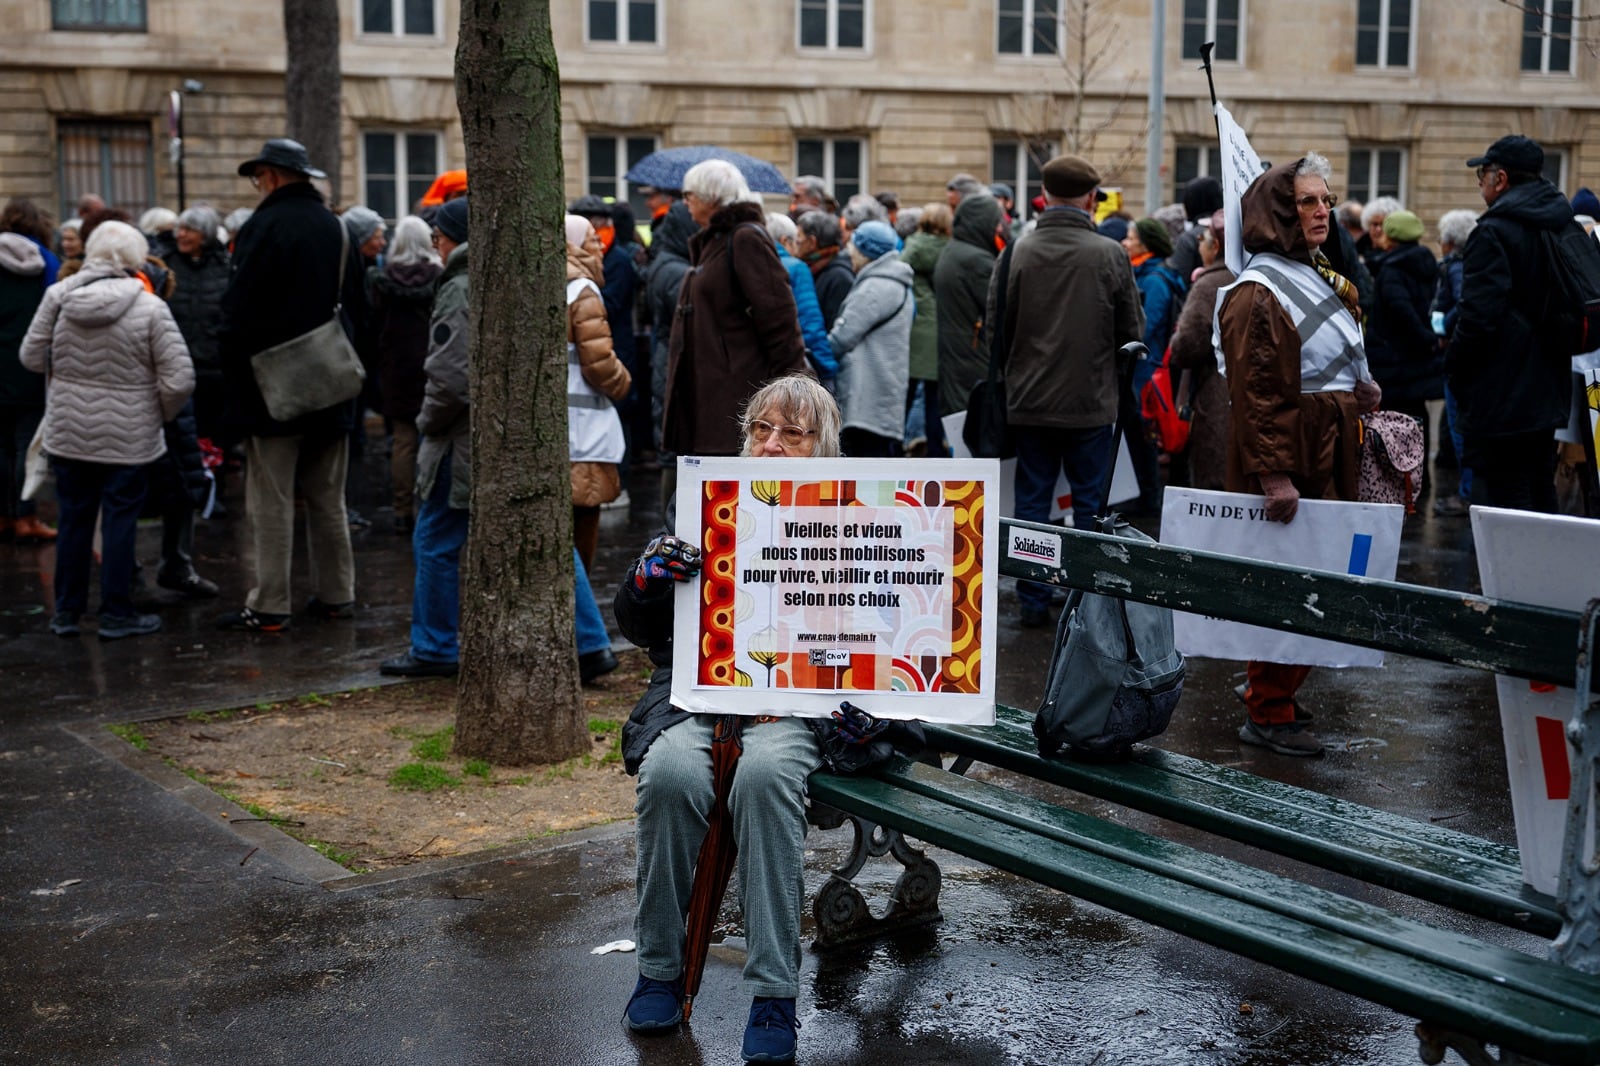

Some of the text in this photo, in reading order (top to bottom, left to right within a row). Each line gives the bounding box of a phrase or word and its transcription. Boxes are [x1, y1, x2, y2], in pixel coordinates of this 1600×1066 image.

[1188, 502, 1216, 518] FIN
[1221, 505, 1244, 520] DE
[785, 522, 902, 538] Vieilles et vieux
[761, 545, 926, 562] nous nous mobilisons
[1014, 536, 1056, 558] Solidaires
[743, 568, 945, 586] pour vivre, vieillir et mourir
[783, 590, 900, 607] selon nos choix
[797, 632, 876, 642] www.cnav-demain.fr
